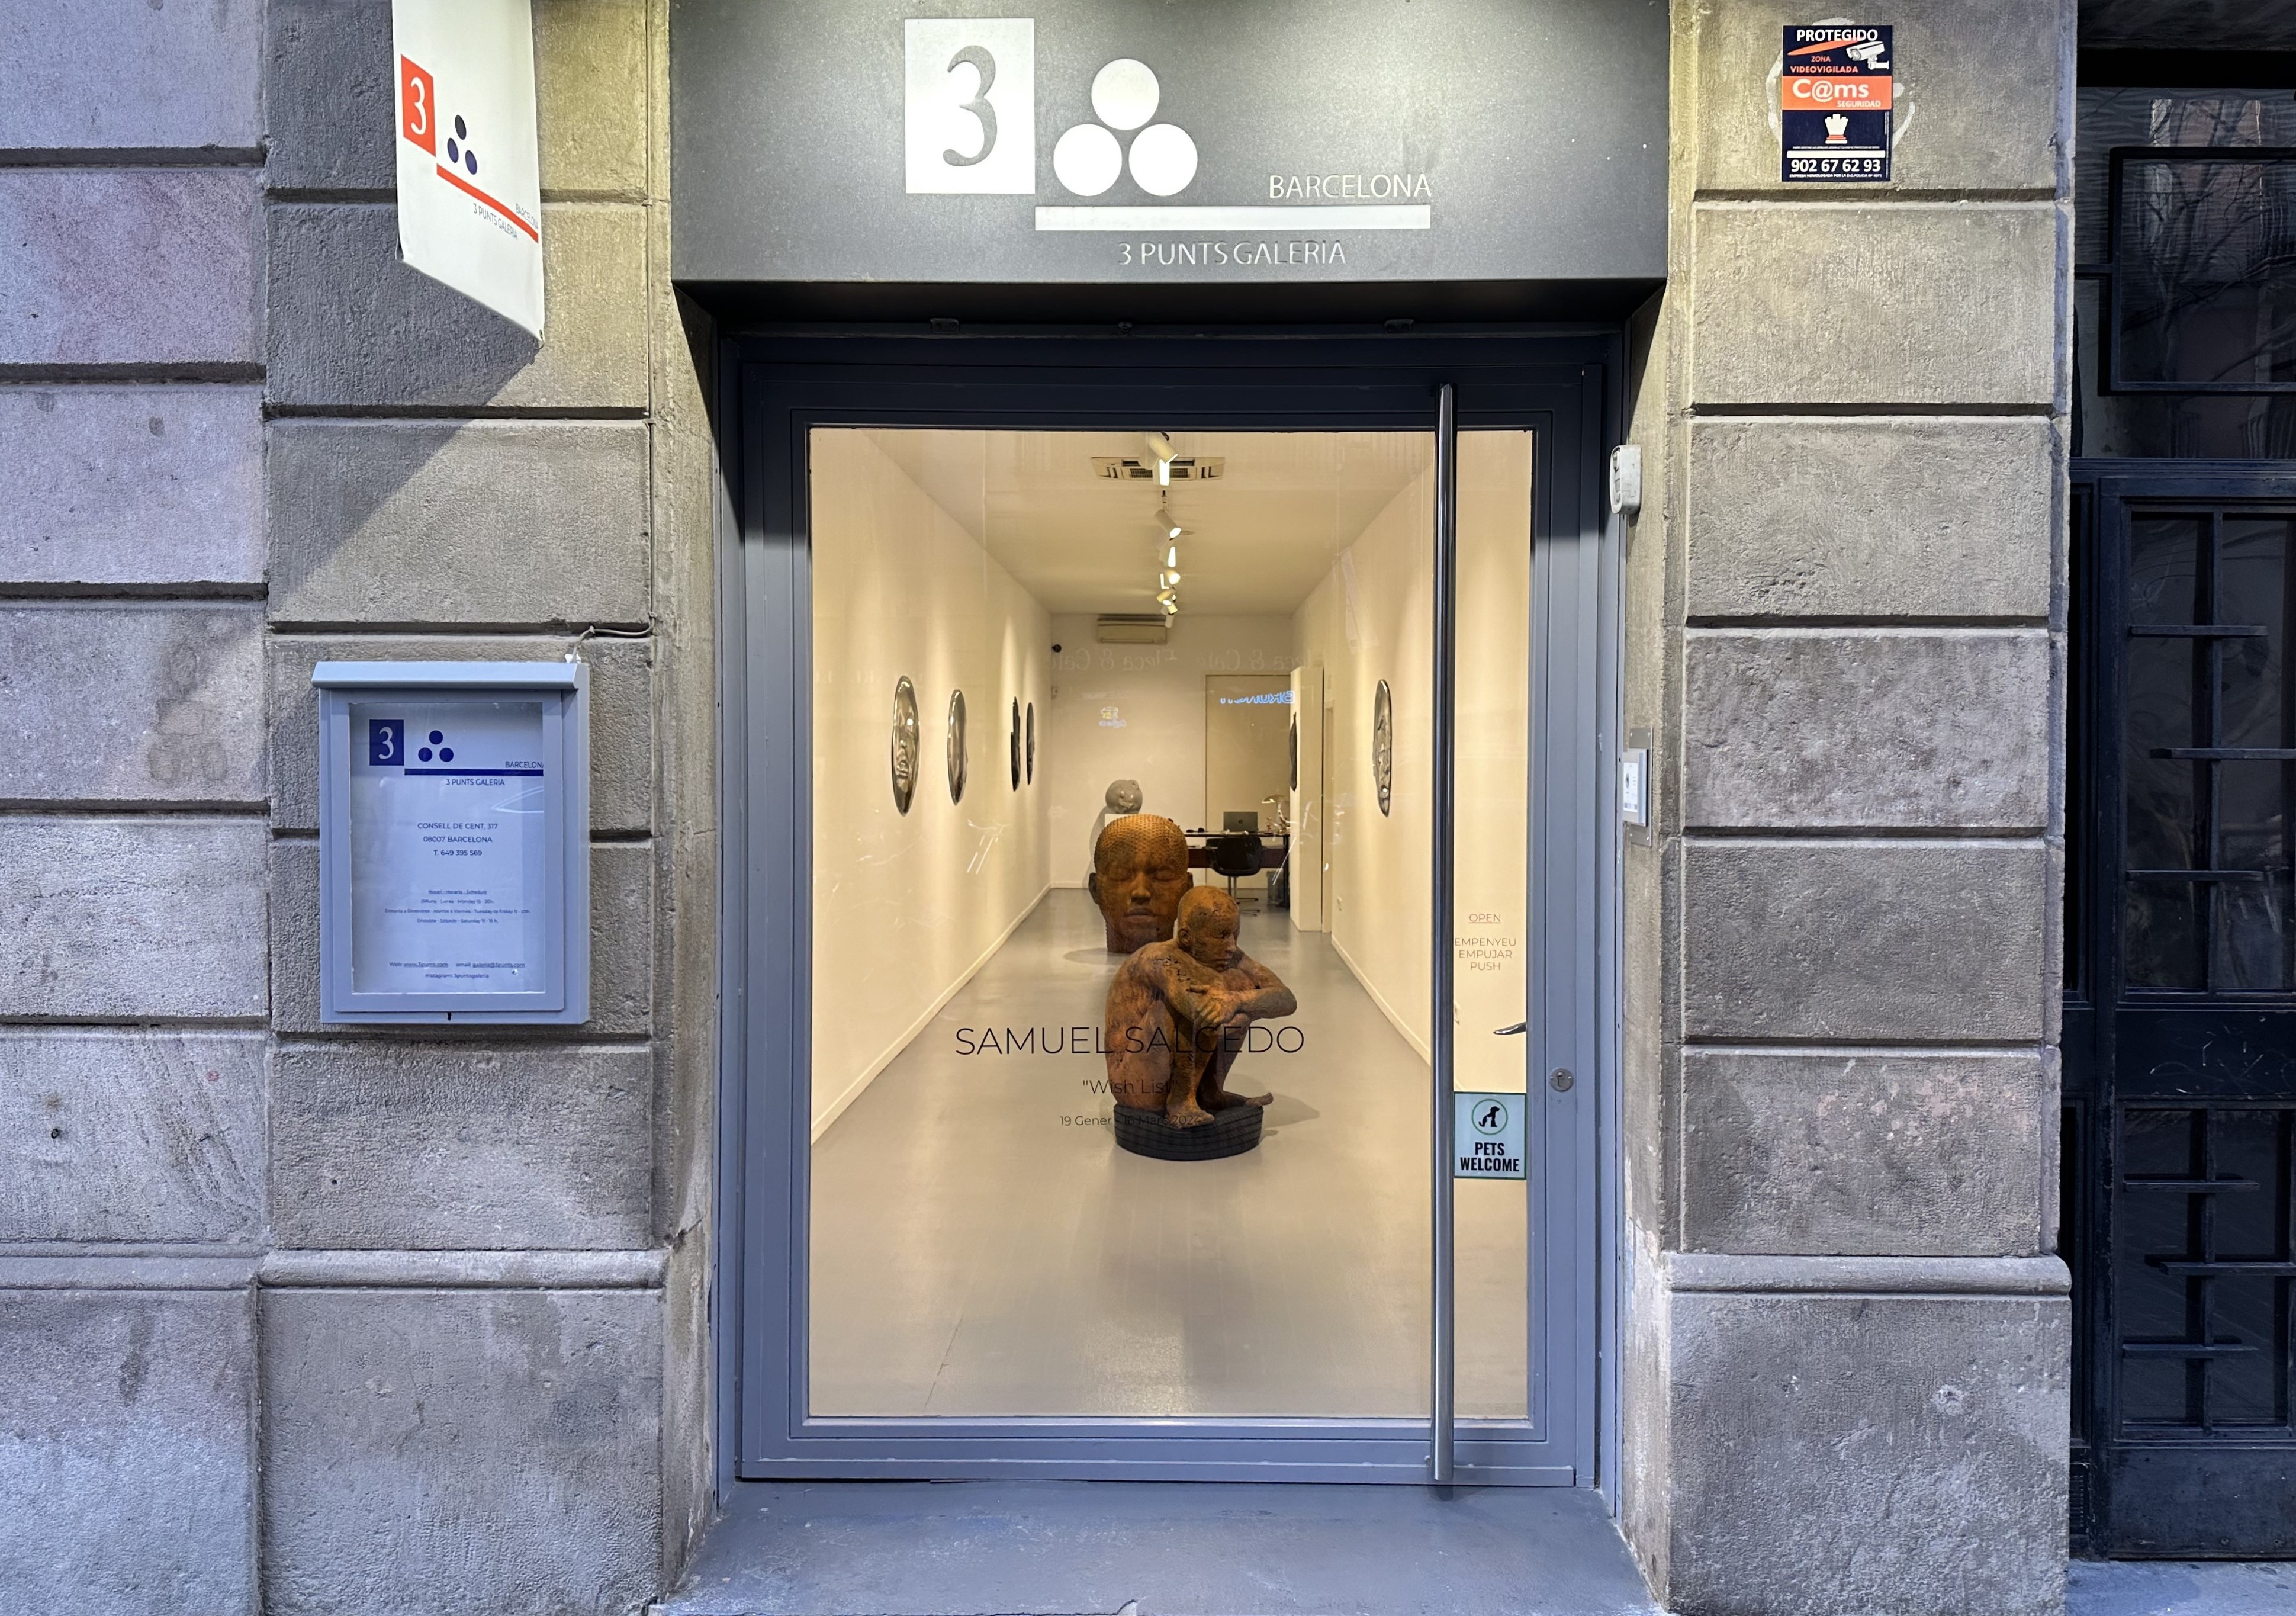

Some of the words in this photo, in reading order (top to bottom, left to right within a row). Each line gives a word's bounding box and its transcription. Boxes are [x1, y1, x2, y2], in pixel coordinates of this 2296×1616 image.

[1796, 29, 1878, 42] PROTEGIDO
[1792, 78, 1869, 102] C@ms
[410, 76, 426, 136] 3
[942, 44, 998, 167] 3
[1790, 159, 1818, 172] 902
[1821, 159, 1839, 172] 67
[1842, 159, 1860, 172] 62
[1863, 159, 1881, 172] 93
[1269, 174, 1432, 198] BARCELONA
[473, 203, 477, 214] 3
[478, 206, 497, 226] PUNTS
[498, 217, 518, 240] GALERIA
[516, 203, 538, 229] BARCELONA
[1117, 243, 1132, 265] 3
[1141, 242, 1229, 265] PUNTS
[1234, 240, 1346, 265] GALERIA
[378, 727, 394, 760] 3
[1468, 913, 1501, 924] OPEN
[1454, 937, 1516, 947] EMPENYEU
[1459, 949, 1513, 959] EMPUJAR
[1469, 961, 1501, 971] PUSH
[955, 1026, 1115, 1055] SAMUEL
[1124, 1026, 1305, 1054] SALCEDO
[1060, 1116, 1072, 1126] 19
[1075, 1116, 1113, 1126] Gener
[1170, 1115, 1202, 1126] 2024
[1474, 1142, 1505, 1155] PETS
[1459, 1157, 1520, 1172] WELCOME
